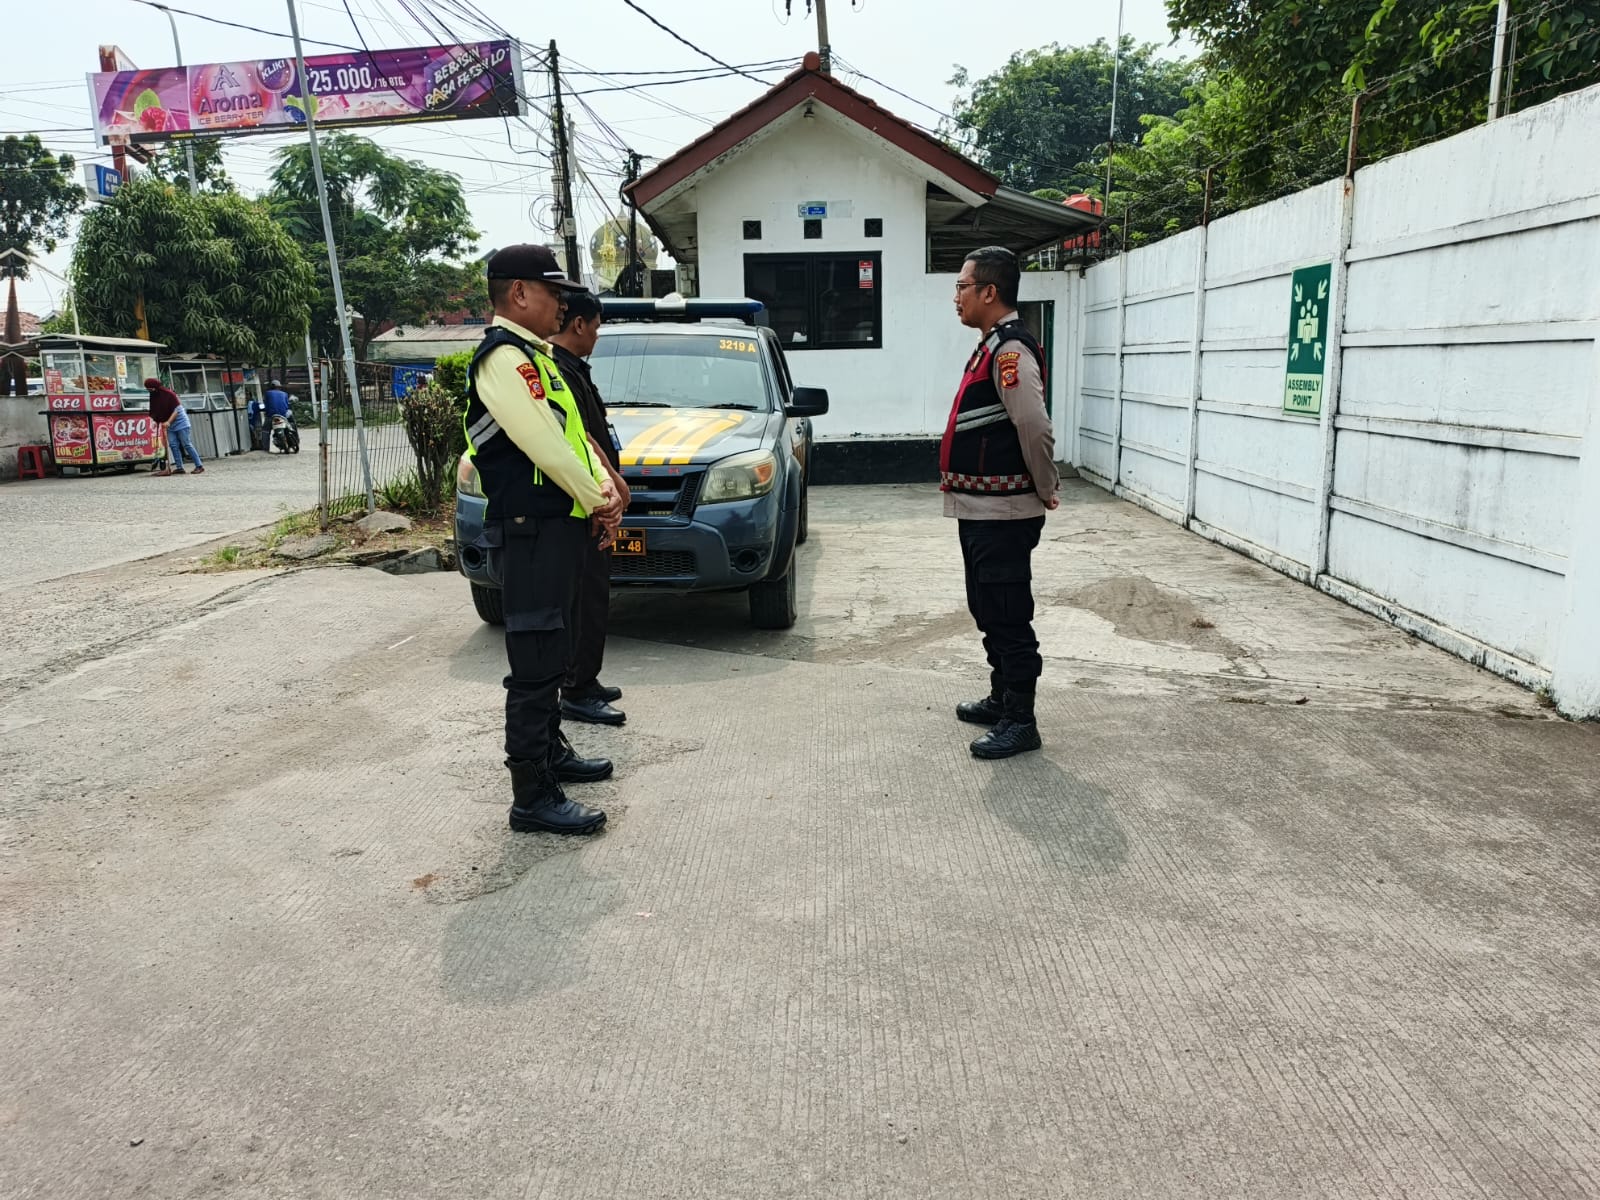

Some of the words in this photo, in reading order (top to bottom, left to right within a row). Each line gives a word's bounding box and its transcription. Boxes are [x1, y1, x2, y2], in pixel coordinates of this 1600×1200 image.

[491, 48, 506, 67] LO
[198, 92, 263, 116] Aroma
[215, 113, 244, 123] BERRY
[246, 110, 264, 119] TEA
[719, 339, 746, 352] 3219
[747, 342, 756, 353] A
[1287, 379, 1321, 392] ASSEMBLY
[52, 398, 81, 409] QFC
[92, 397, 119, 408] QFC
[1292, 394, 1313, 407] POINT
[114, 418, 147, 437] QFC
